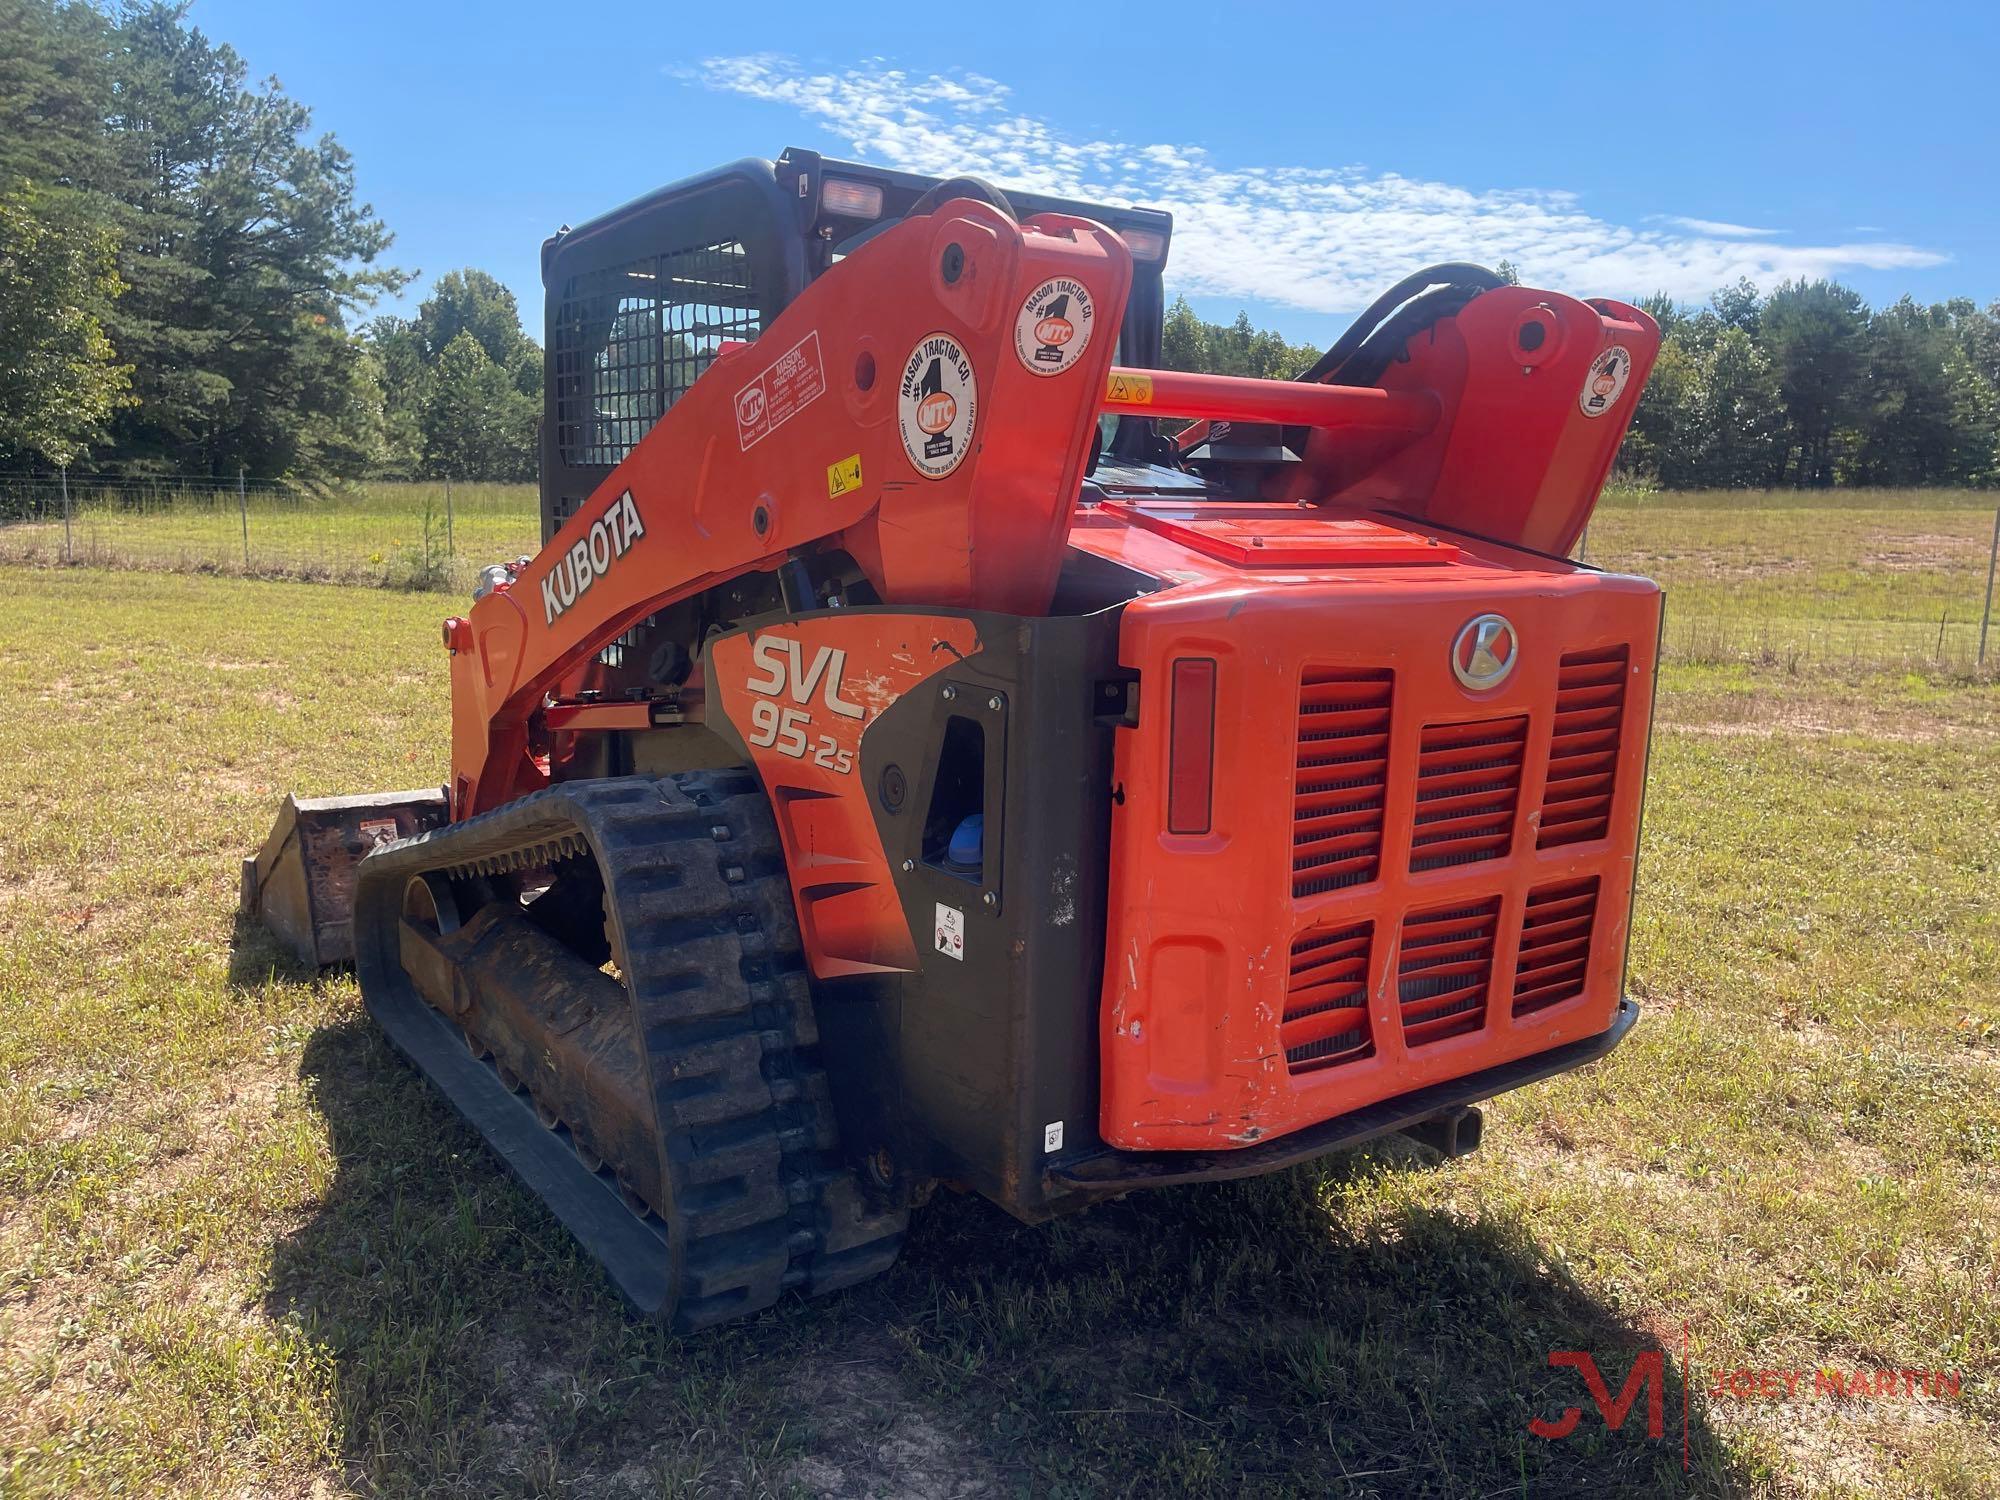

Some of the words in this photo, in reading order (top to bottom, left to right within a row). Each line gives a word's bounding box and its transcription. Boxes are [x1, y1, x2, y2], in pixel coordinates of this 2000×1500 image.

[1026, 283, 1053, 312] MASON
[1056, 281, 1088, 306] TRACTOR
[1081, 305, 1092, 322] CO.
[1039, 322, 1071, 341] MTC
[772, 365, 797, 390] TRACTOR
[775, 348, 802, 375] MASON
[902, 350, 924, 398] MASON
[924, 339, 960, 366] TRACTOR
[958, 360, 970, 387] CO.
[921, 399, 955, 428] MTC
[541, 489, 645, 625] KUBOTA
[747, 634, 866, 720] SVL
